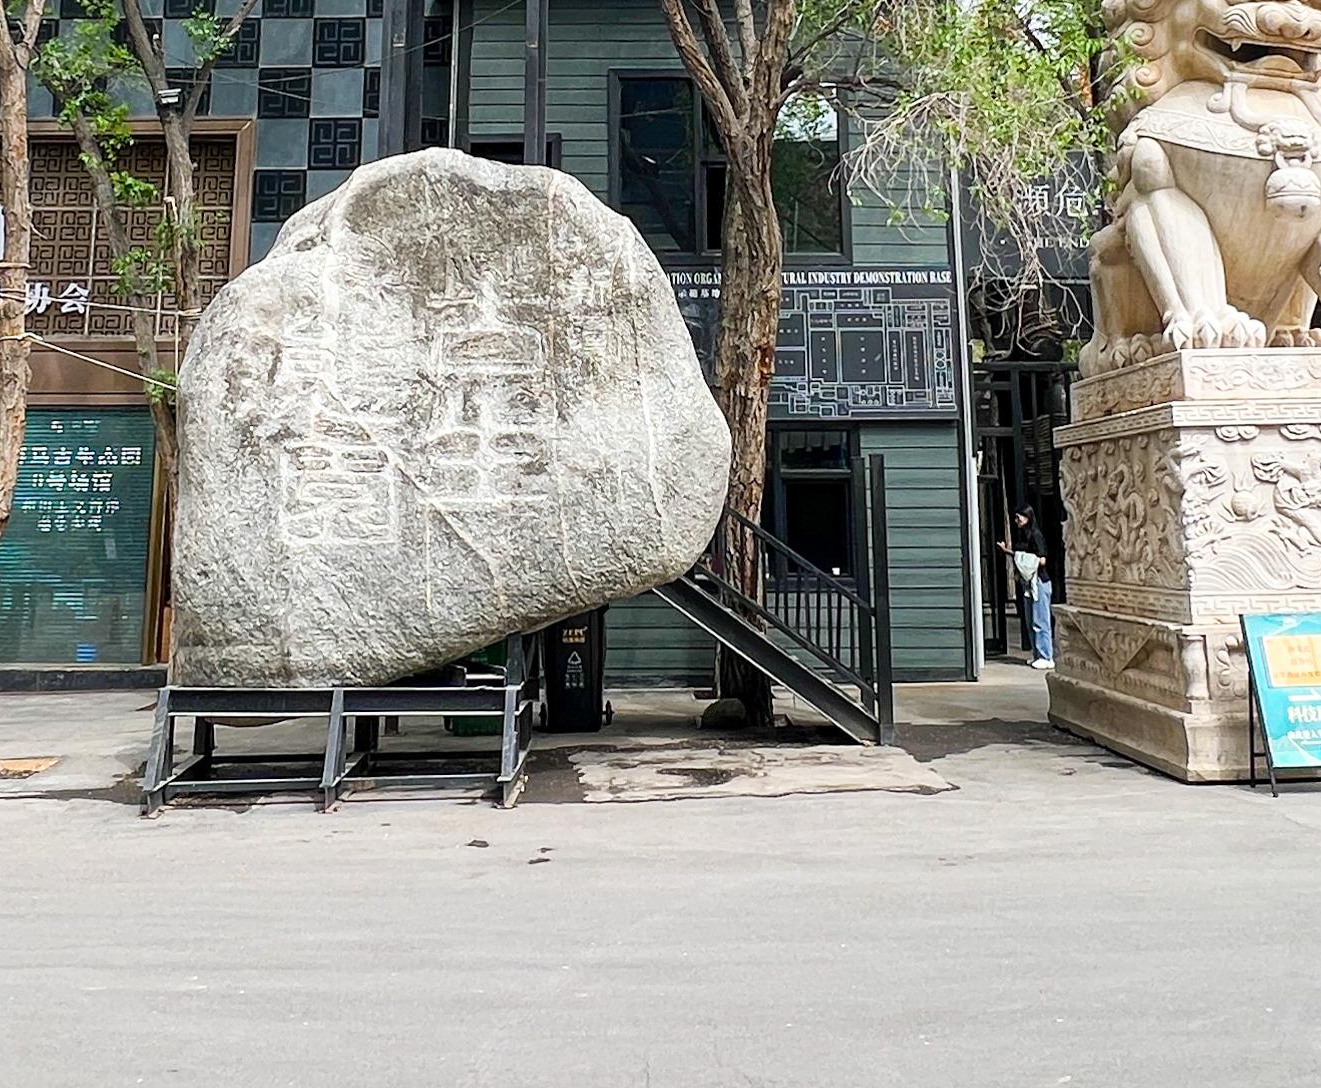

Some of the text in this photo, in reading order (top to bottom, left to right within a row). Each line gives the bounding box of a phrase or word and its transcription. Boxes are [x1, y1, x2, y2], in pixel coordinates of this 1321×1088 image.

[808, 271, 851, 286] INDUSTRY
[853, 271, 928, 286] DEMONSTRATION
[929, 271, 952, 284] BASE
